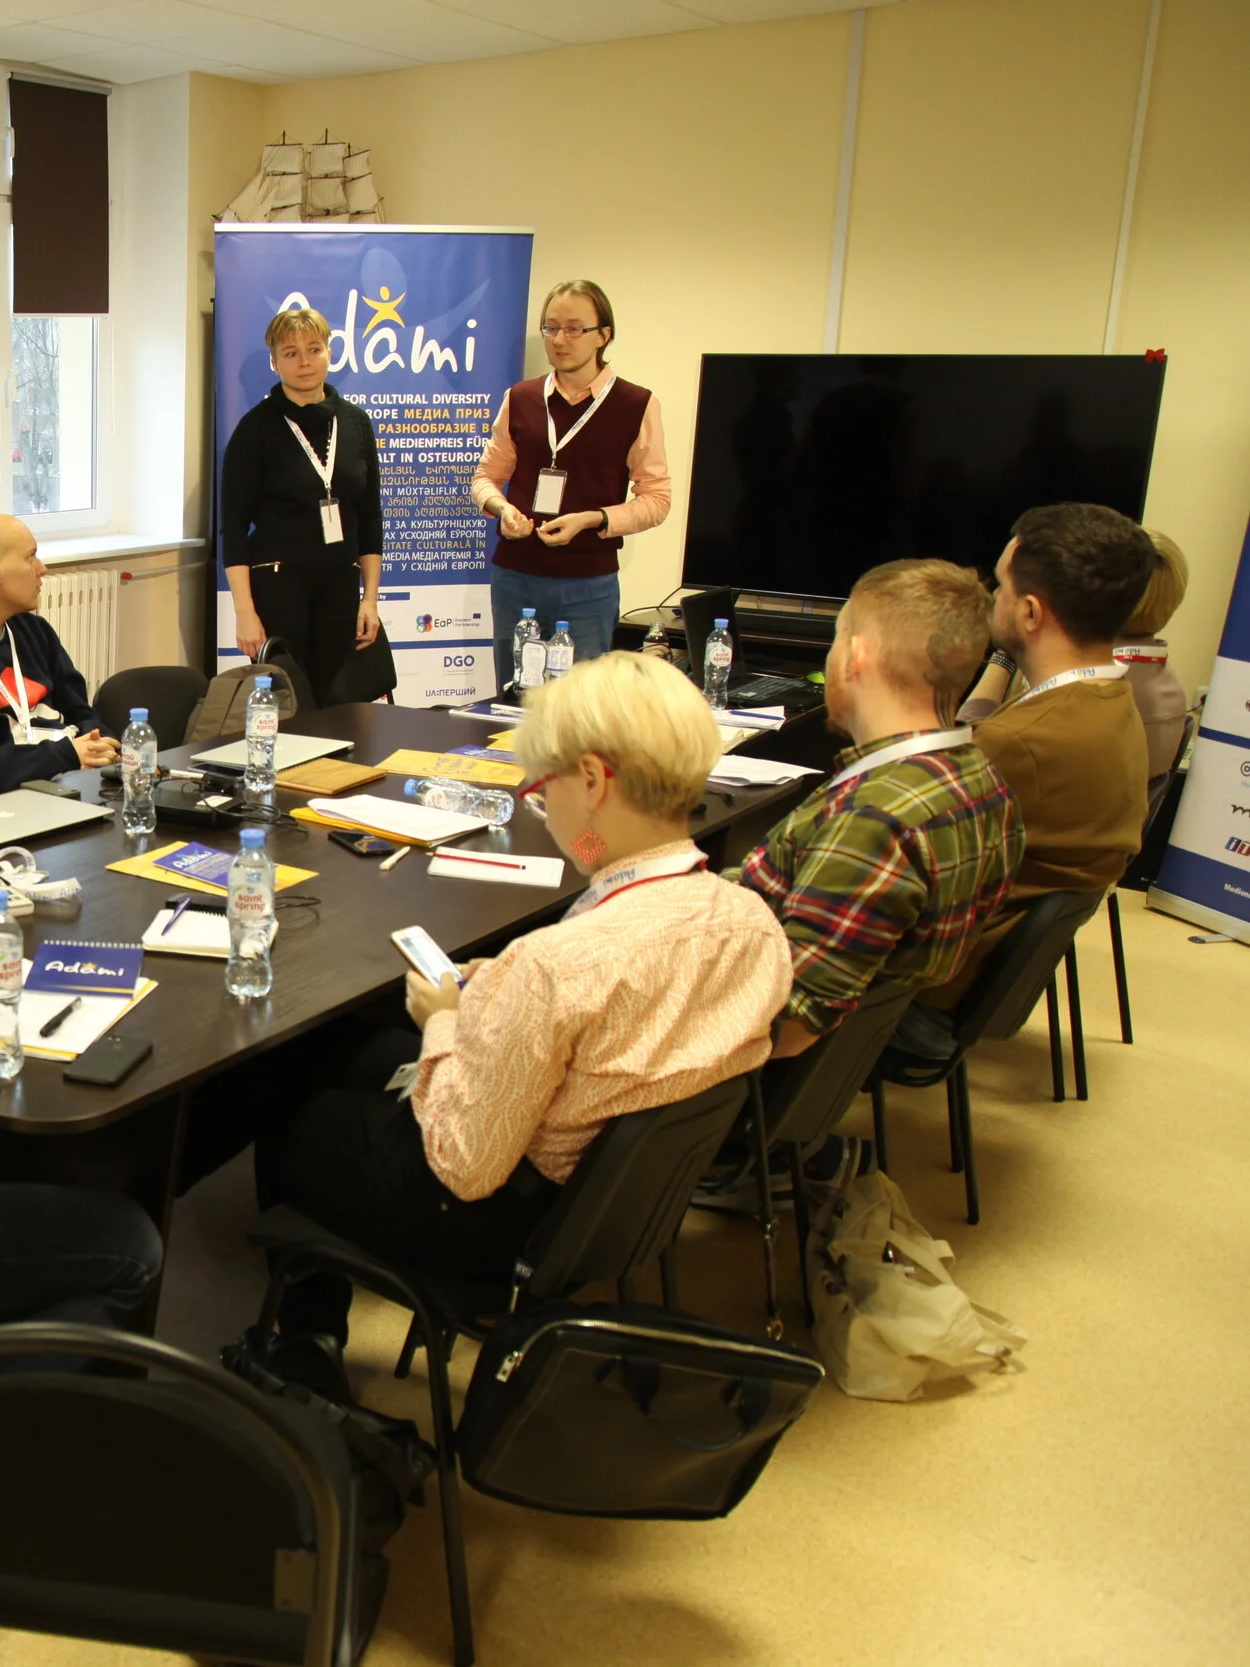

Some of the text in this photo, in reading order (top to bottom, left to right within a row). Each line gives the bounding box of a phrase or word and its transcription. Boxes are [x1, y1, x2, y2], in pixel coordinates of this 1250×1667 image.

[343, 393, 491, 405] FOR CULTURAL DIVERSITY
[404, 408, 450, 421] МЕДИА
[456, 408, 491, 419] ПРИЗ
[378, 423, 477, 434] РАЗНООБРАЗИЕ
[389, 437, 464, 449] MEDIENPREIS
[400, 452, 413, 463] IN
[418, 452, 481, 463] OSTEUROP
[395, 520, 407, 529] ЗА
[474, 551, 486, 559] ЗА
[434, 618, 453, 628] EaP
[443, 655, 475, 668] DGO
[45, 960, 126, 977] Adami
